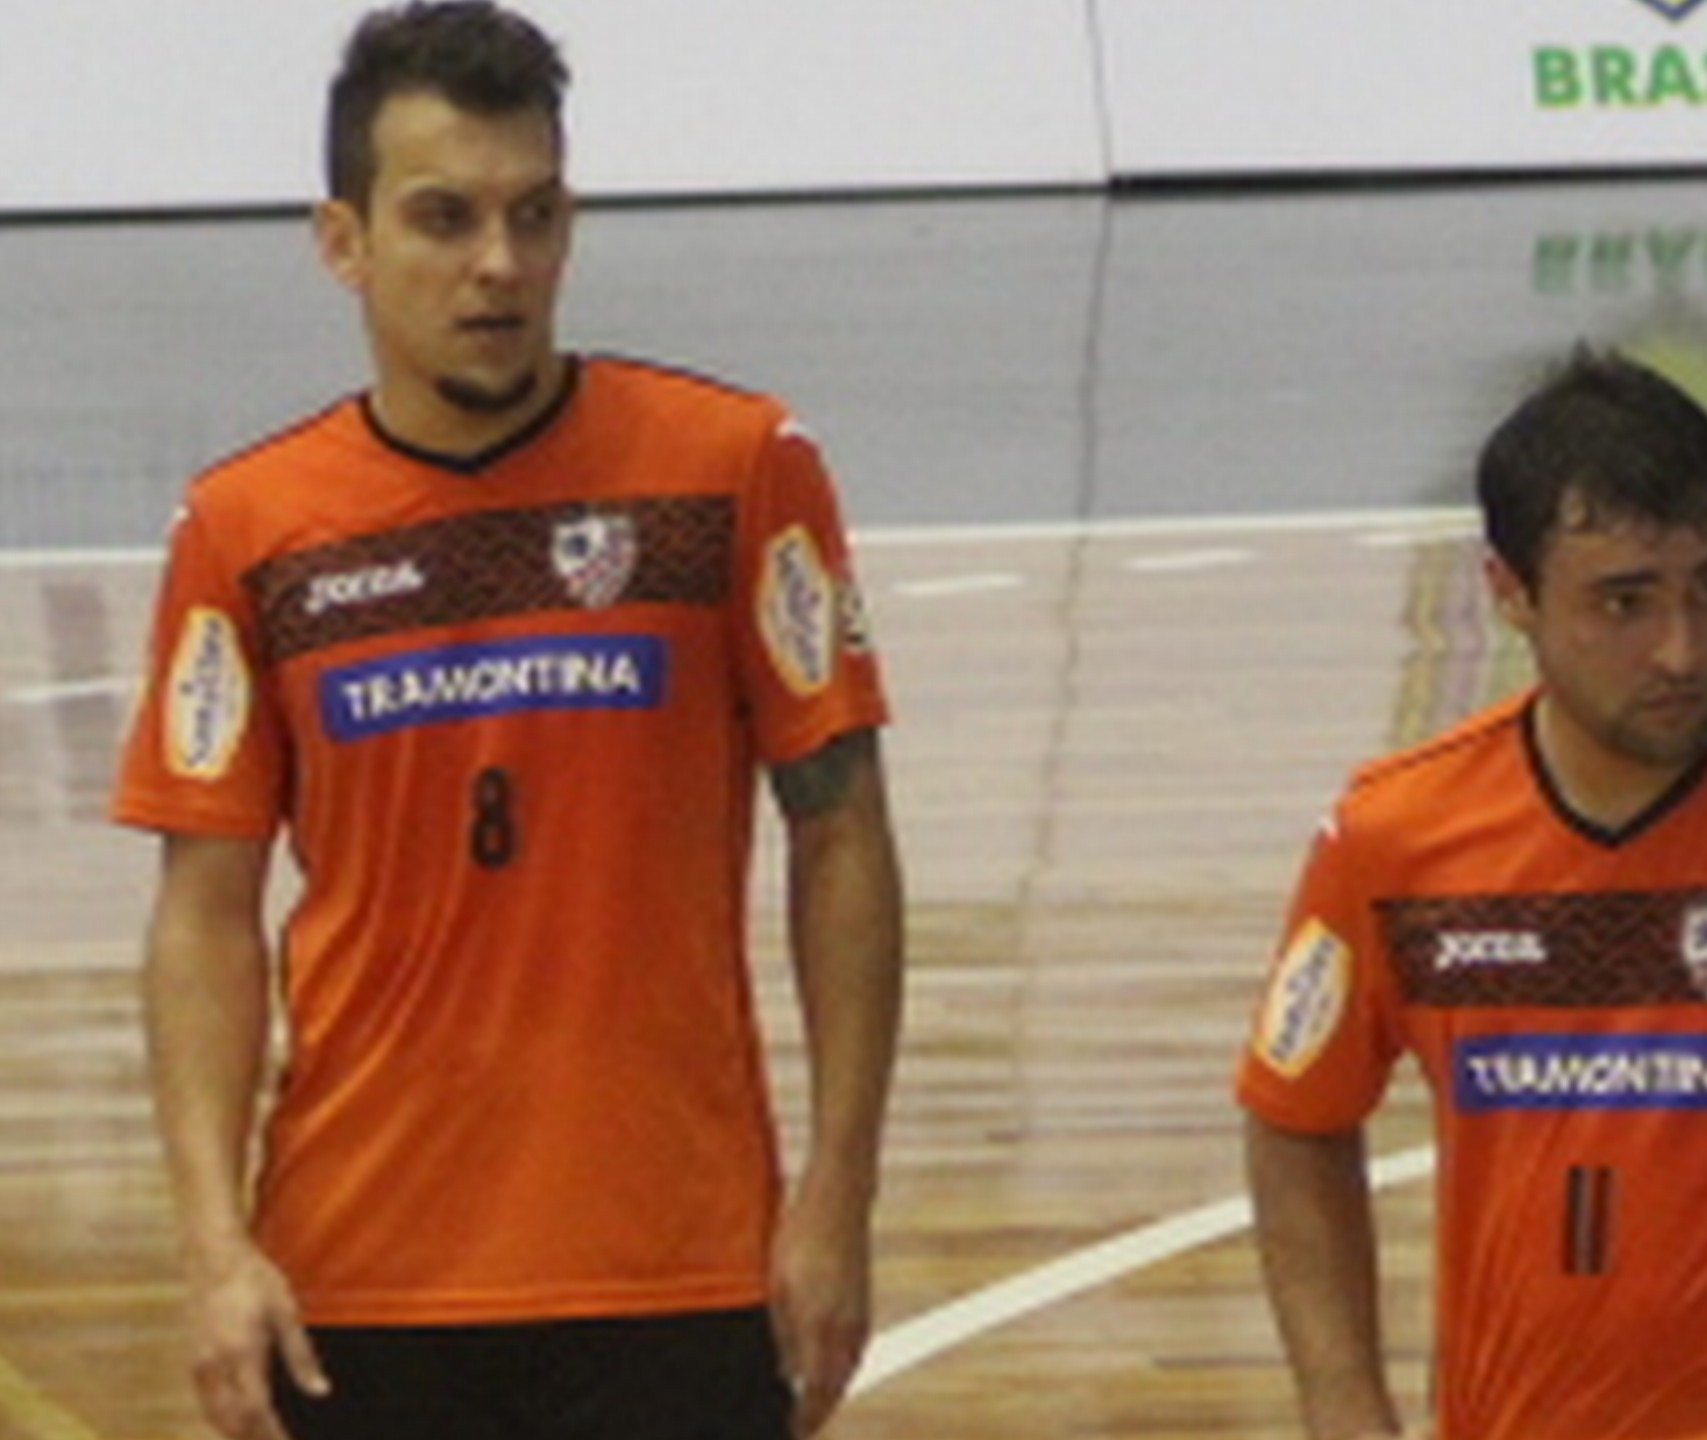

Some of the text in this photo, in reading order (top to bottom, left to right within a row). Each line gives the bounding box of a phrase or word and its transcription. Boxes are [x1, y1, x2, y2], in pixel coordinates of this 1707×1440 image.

[342, 653, 641, 723] TRAMONTINA
[470, 768, 516, 870] 8
[1564, 1166, 1616, 1277] 11
